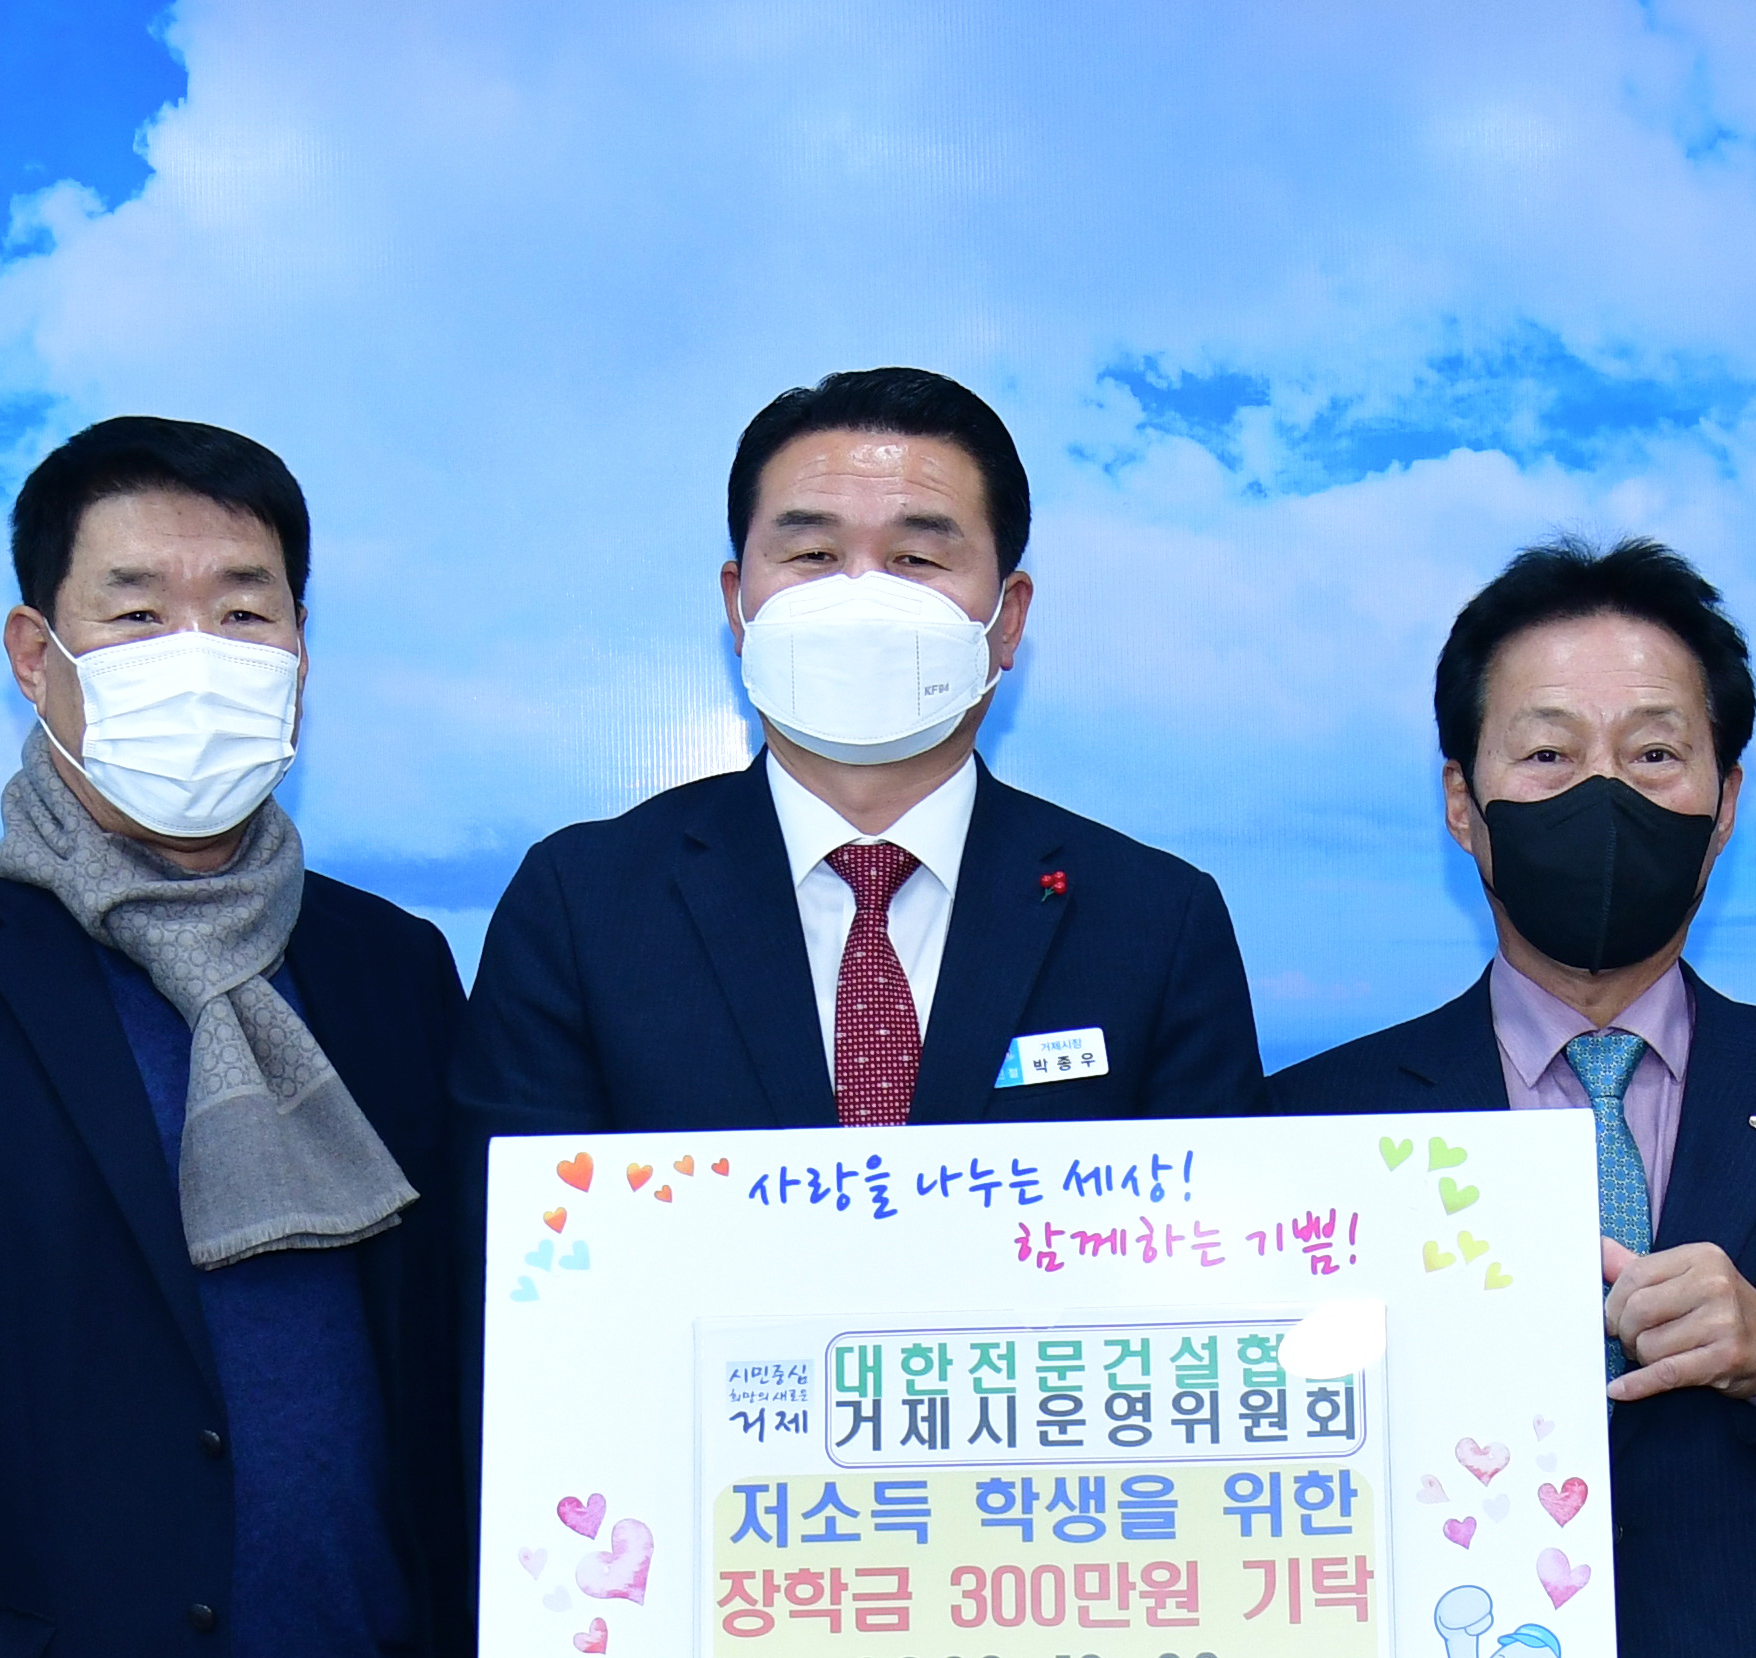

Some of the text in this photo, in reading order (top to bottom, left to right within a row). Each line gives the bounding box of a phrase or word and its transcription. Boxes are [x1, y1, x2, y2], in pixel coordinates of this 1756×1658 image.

[1033, 1053, 1095, 1073] 박종우
[749, 1150, 1193, 1219] 사랑을 나누는 세상!
[1014, 1208, 1358, 1275] 함께하는 기쁨!
[729, 1364, 807, 1385] 시민중심
[729, 1388, 807, 1403] 희망의 새로운
[834, 1334, 1354, 1398] 대한전문건설협
[729, 1407, 808, 1442] 거제
[835, 1386, 1356, 1451] 거제시운영위원회
[730, 1469, 1358, 1548] 저소득 학생을 위한
[717, 1555, 1374, 1638] 장학금 300만원 기탁
